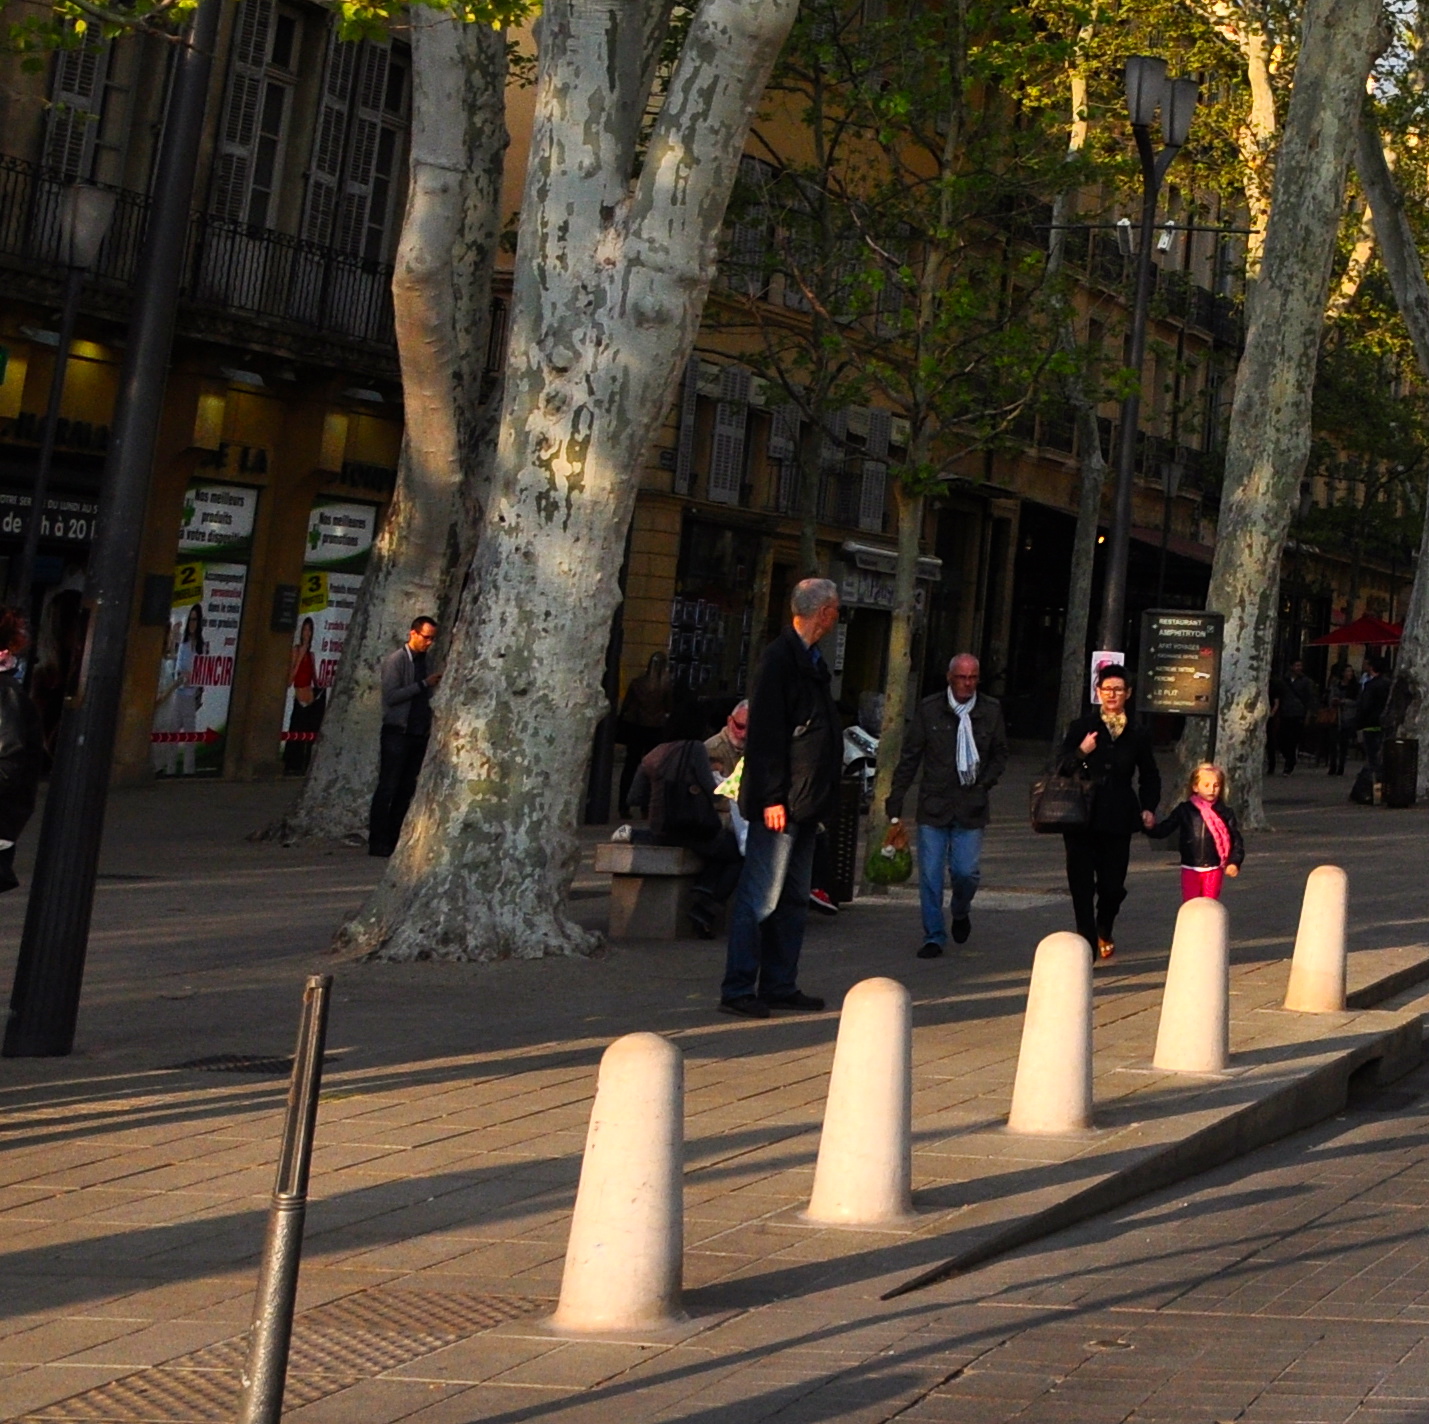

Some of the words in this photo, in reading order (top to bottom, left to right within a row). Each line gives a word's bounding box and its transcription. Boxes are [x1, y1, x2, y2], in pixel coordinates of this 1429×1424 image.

[195, 488, 209, 503] Nos
[210, 492, 245, 507] meilleurs
[2, 511, 22, 534] de
[54, 515, 65, 537] à
[68, 518, 87, 540] 20
[201, 510, 233, 526] produits
[319, 511, 332, 526] Nos
[186, 528, 206, 543] votre
[321, 533, 359, 547] promotions
[181, 566, 196, 586] 2
[307, 575, 322, 593] 3
[1158, 618, 1204, 626] RESTAURANT
[1158, 629, 1207, 638] AMPHITRYON
[321, 637, 329, 653] le
[190, 655, 233, 686] MINCIR
